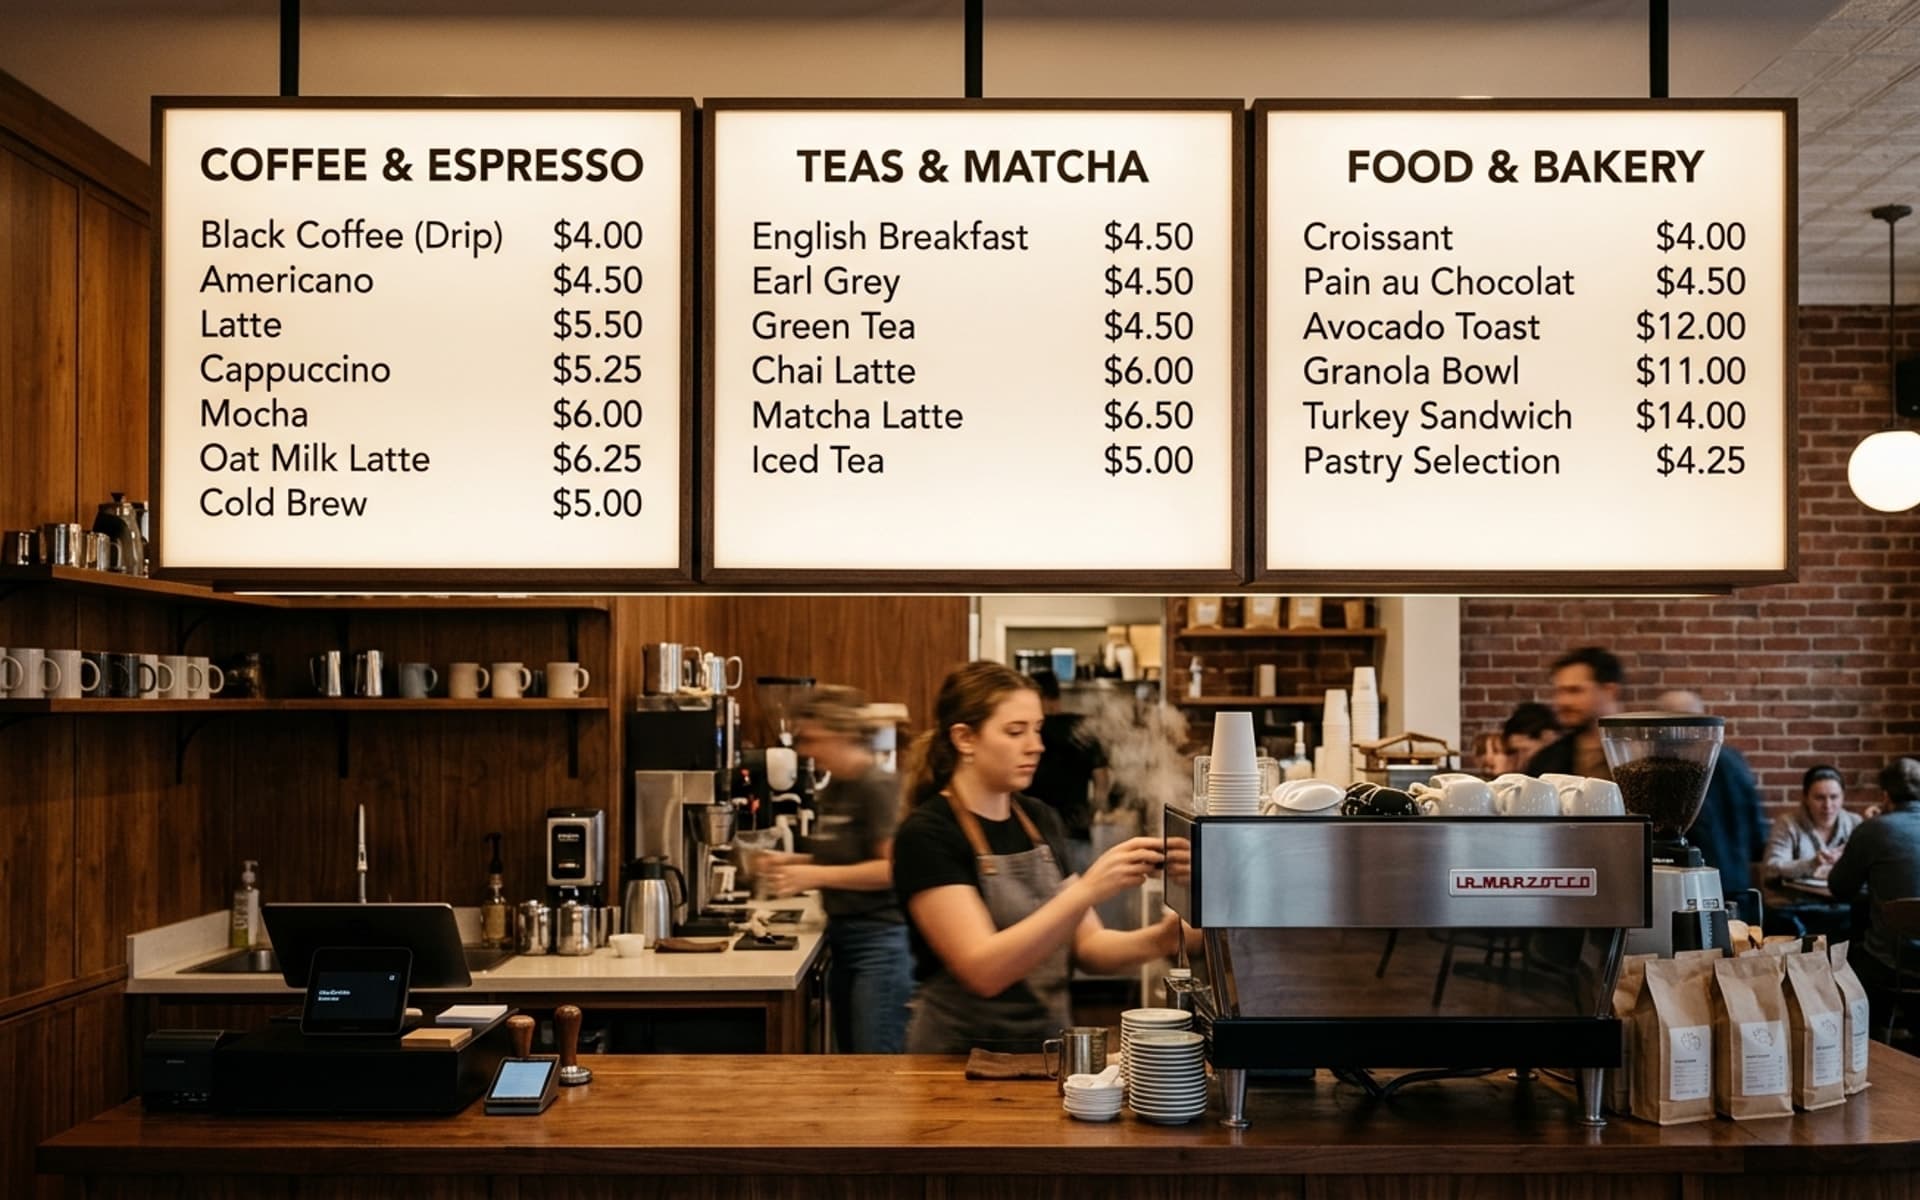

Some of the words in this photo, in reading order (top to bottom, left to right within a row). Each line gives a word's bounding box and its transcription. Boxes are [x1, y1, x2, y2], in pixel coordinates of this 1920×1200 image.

[201, 147, 366, 182] COFFEE
[383, 148, 412, 182] &
[429, 148, 643, 182] ESPRESSO
[797, 149, 904, 183] TEAS
[919, 149, 949, 183] &
[965, 150, 1149, 183] MATCHA
[1349, 150, 1473, 183] FOOD
[1488, 150, 1518, 183] &
[1535, 150, 1704, 183] BAKERY
[202, 218, 285, 249] Black
[297, 218, 403, 249] Coffee
[416, 219, 503, 259] (Drip)
[553, 218, 643, 252] $4.00
[754, 220, 866, 259] English
[880, 220, 1029, 251] Breakfast
[1104, 220, 1194, 254] $4.50
[1304, 221, 1453, 251] Croissant
[1656, 220, 1746, 254] $4.00
[200, 265, 374, 294] Americano
[553, 263, 643, 297] $4.50
[754, 265, 812, 295] Earl
[824, 266, 901, 303] Grey
[1104, 264, 1194, 298] $4.50
[1305, 267, 1370, 296] Pain
[1382, 276, 1419, 296] au
[1431, 266, 1575, 296] Chocolat
[1656, 265, 1746, 299] $4.50
[201, 310, 282, 339] Latte
[553, 308, 643, 342] $5.50
[753, 311, 850, 340] Green
[861, 312, 915, 340] Tea
[1104, 309, 1194, 343] $4.50
[1303, 310, 1445, 341] Avocado
[1455, 312, 1541, 341] Toast
[1636, 309, 1746, 344] $12.00
[200, 354, 391, 392] Cappuccino
[553, 352, 642, 386] $5.25
[753, 354, 823, 385] Chai
[836, 356, 916, 385] Latte
[1104, 354, 1194, 388] $6.00
[1303, 355, 1430, 385] Granola
[1443, 355, 1519, 385] Bowl
[1636, 354, 1746, 388] $11.00
[201, 398, 308, 428] Mocha
[553, 397, 643, 431] $6.00
[754, 399, 870, 430] Matcha
[884, 401, 964, 430] Latte
[1104, 399, 1194, 433] $6.50
[1303, 400, 1410, 438] Turkey
[1420, 400, 1572, 430] Sandwich
[1636, 399, 1746, 433] $14.00
[200, 443, 260, 473] Oat
[272, 442, 338, 472] Milk
[351, 444, 431, 473] Latte
[553, 442, 642, 476] $6.25
[754, 444, 819, 474] Iced
[830, 446, 884, 474] Tea
[1104, 443, 1194, 477] $5.00
[1304, 446, 1403, 483] Pastry
[1414, 444, 1560, 475] Selection
[1656, 444, 1746, 478] $4.25
[200, 487, 274, 517] Cold
[288, 489, 368, 517] Brew
[553, 487, 642, 520] $5.00
